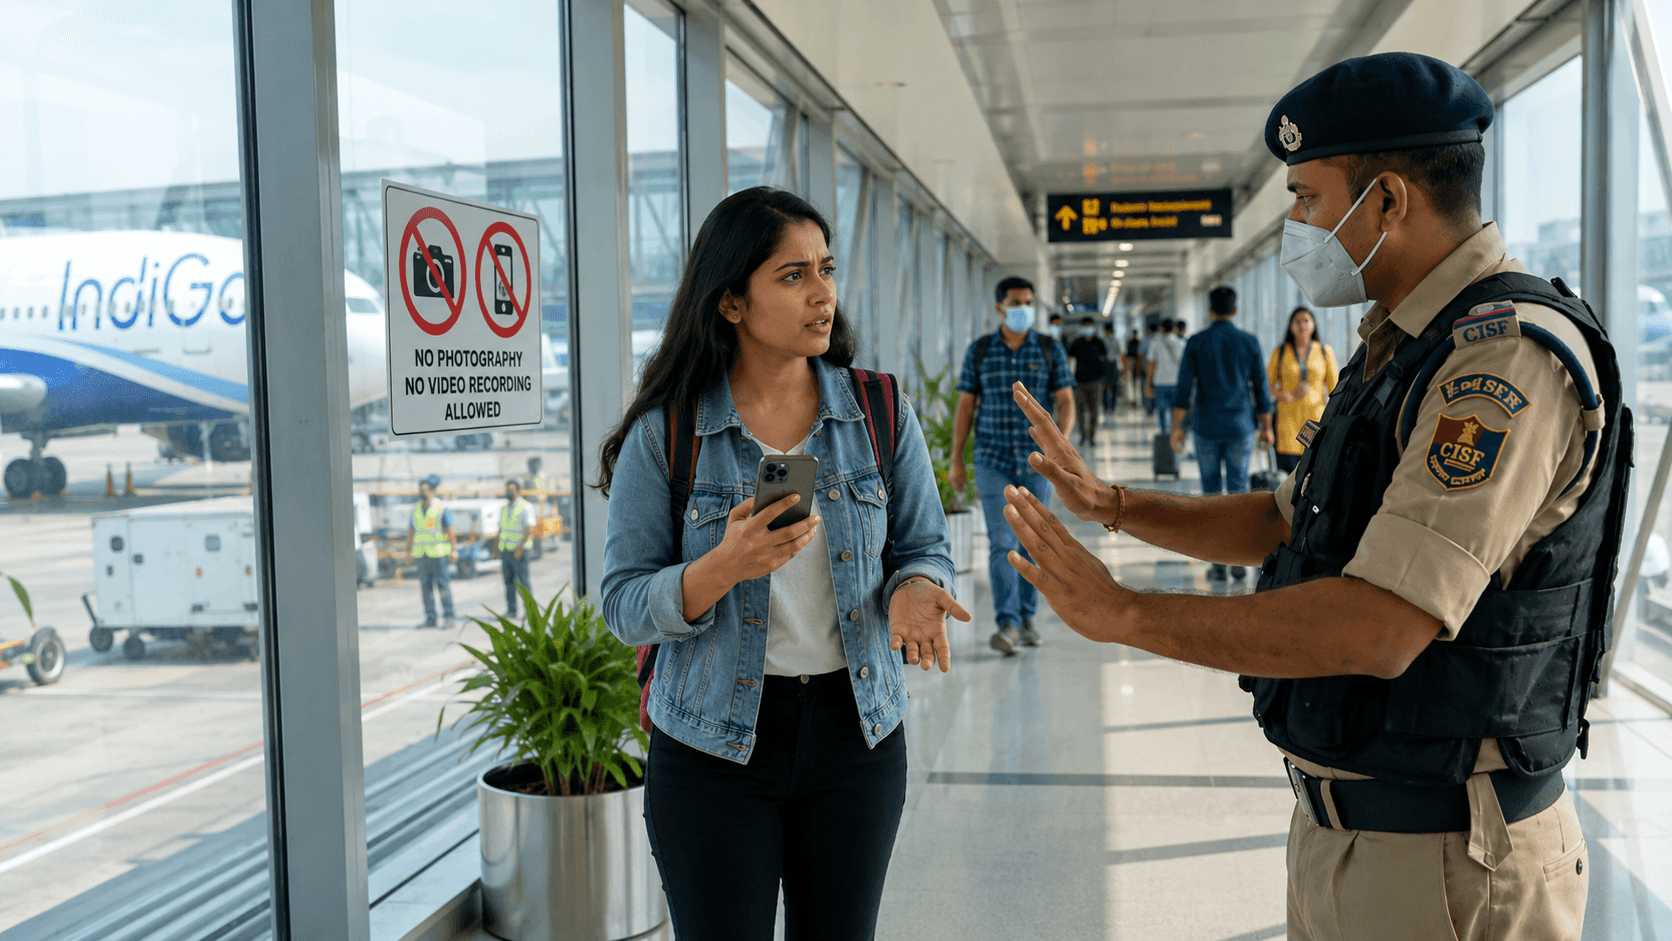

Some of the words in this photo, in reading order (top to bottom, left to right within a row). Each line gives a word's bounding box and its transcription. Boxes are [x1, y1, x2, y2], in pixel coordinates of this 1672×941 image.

[1463, 320, 1508, 343] CISF
[415, 349, 434, 367] NO
[438, 349, 523, 367] PHOTOGRAPHY
[405, 377, 425, 395] NO
[428, 377, 466, 394] VIDEO
[469, 375, 531, 393] RECORDING
[445, 401, 501, 420] ALLOWED
[1440, 442, 1485, 467] CISF
